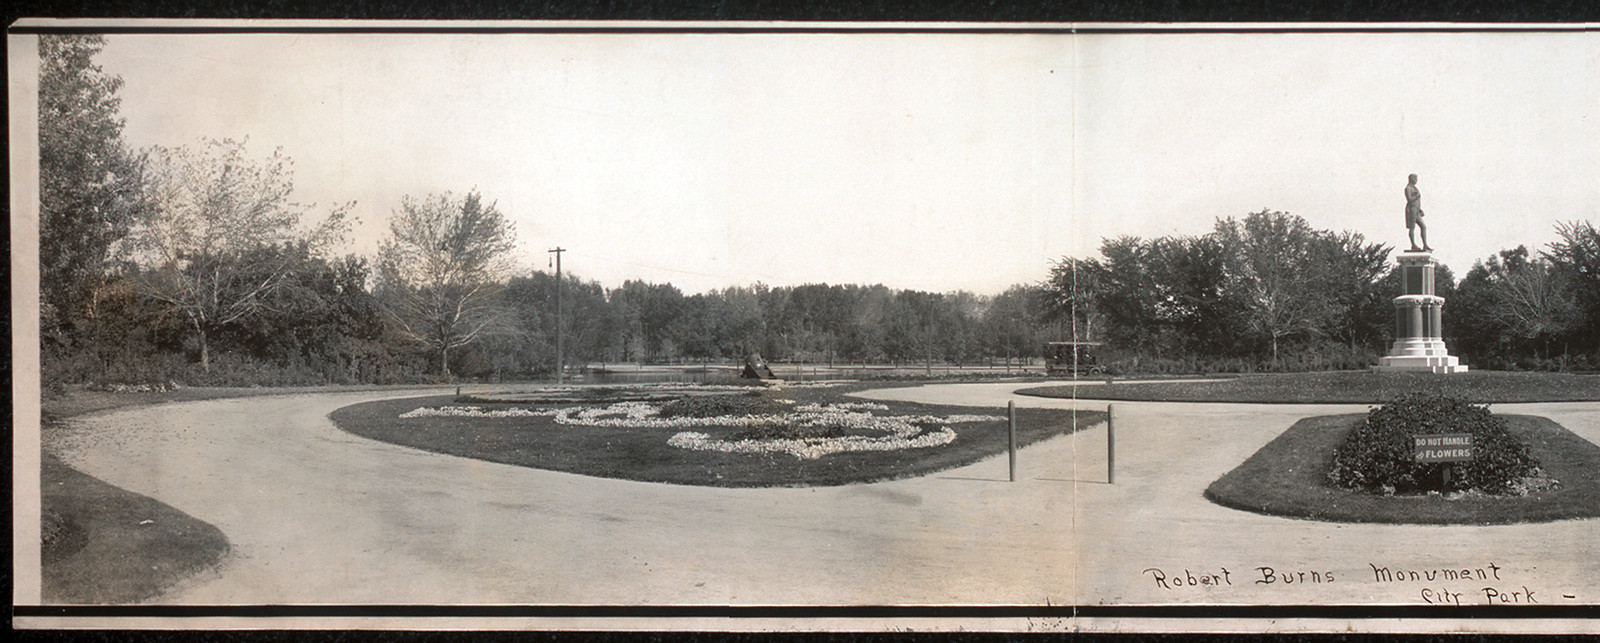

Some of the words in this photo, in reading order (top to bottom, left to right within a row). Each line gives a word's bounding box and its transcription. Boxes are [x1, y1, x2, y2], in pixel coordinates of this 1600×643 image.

[1416, 438, 1426, 446] DO
[1428, 438, 1441, 446] NOT
[1443, 437, 1470, 445] HANDLE
[1426, 449, 1471, 458] FLOWERS
